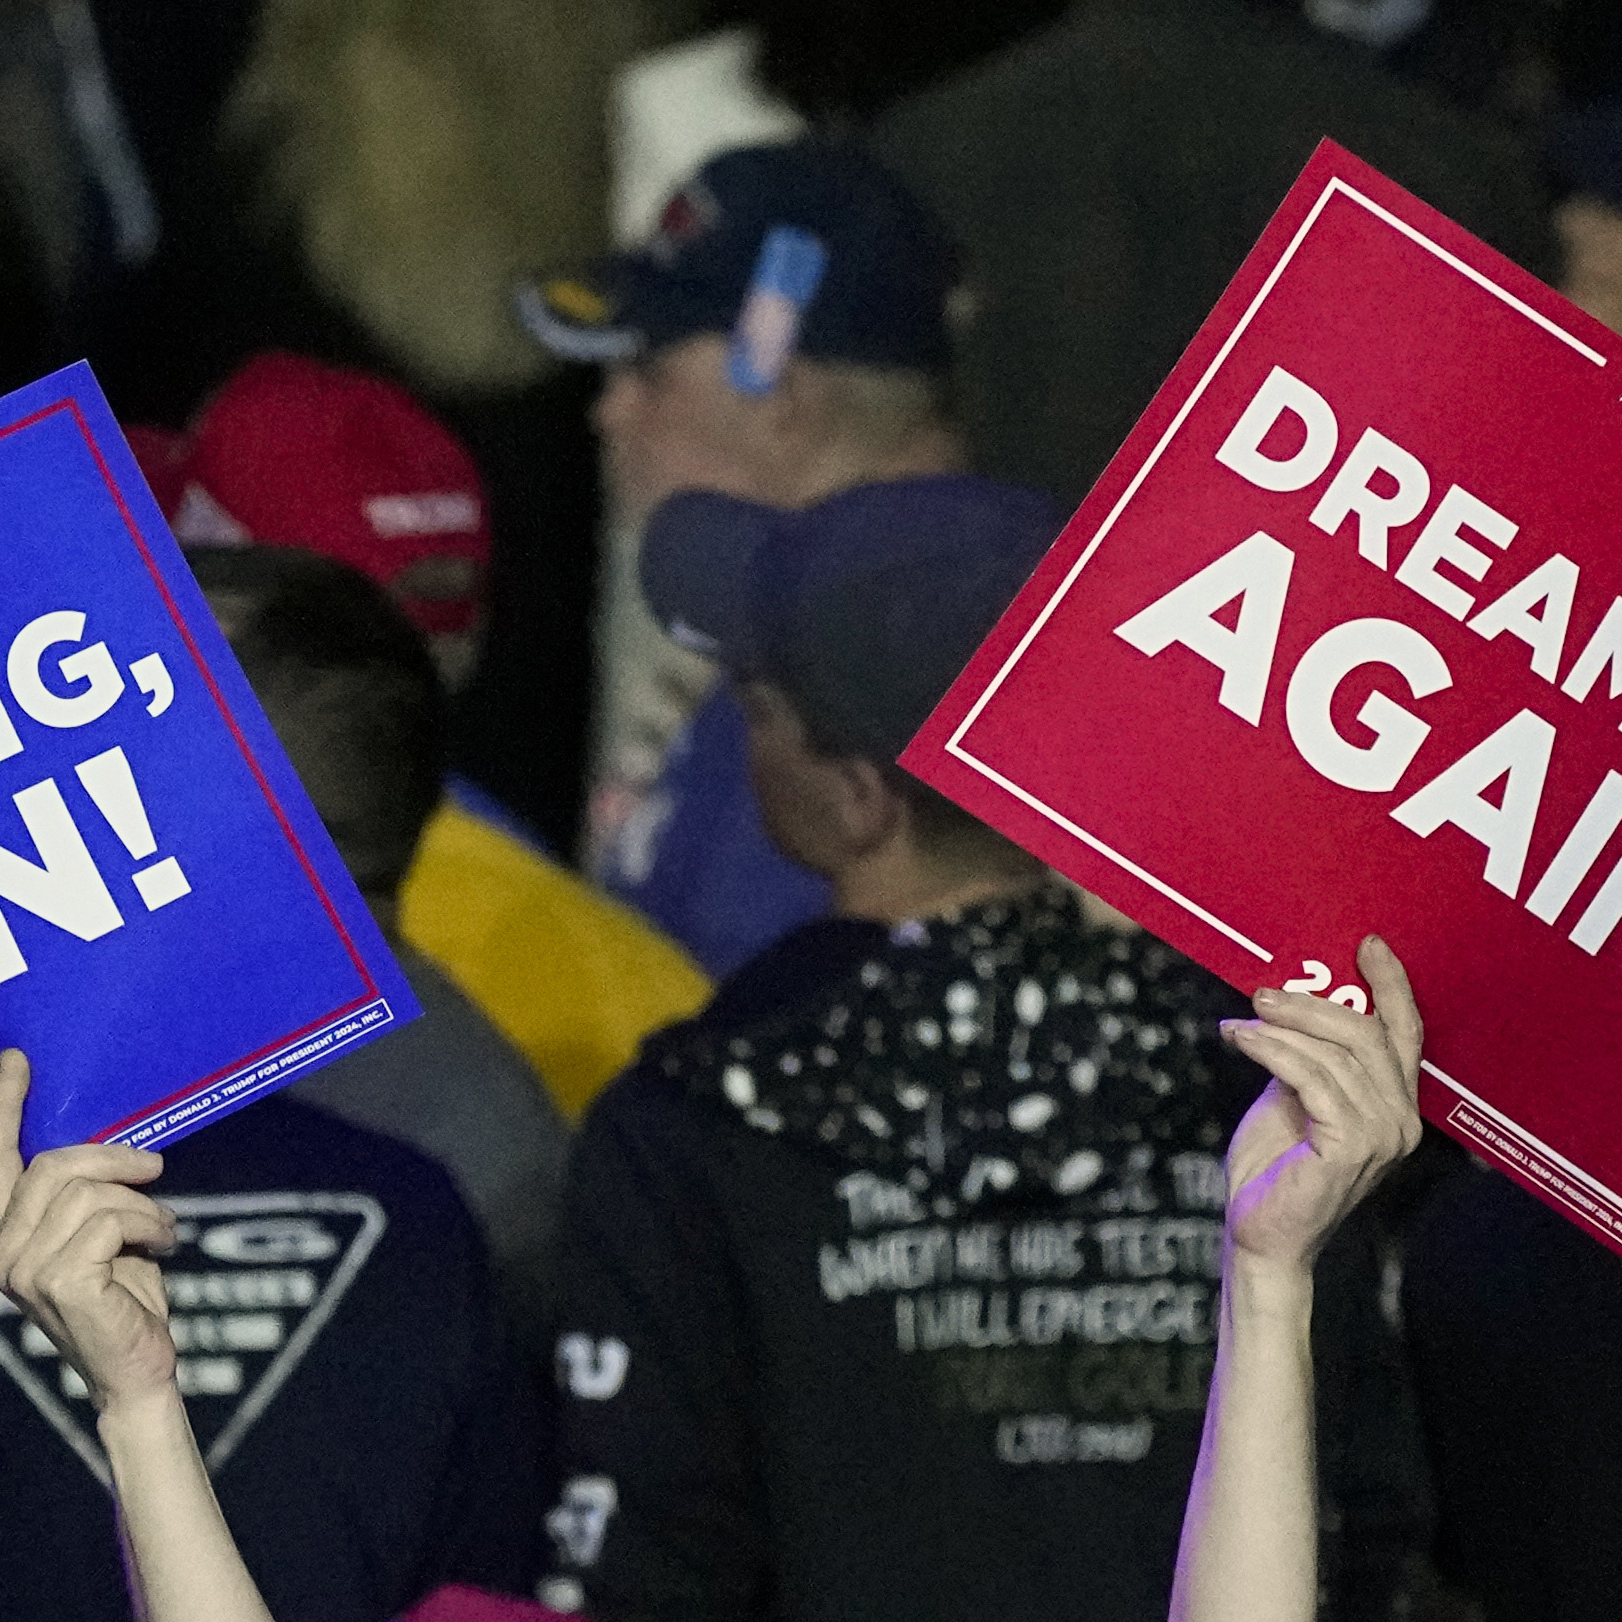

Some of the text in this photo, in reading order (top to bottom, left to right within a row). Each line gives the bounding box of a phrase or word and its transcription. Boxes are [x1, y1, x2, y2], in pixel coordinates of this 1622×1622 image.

[1282, 959, 1368, 1016] 20
[131, 1127, 153, 1143] FOR
[153, 1118, 167, 1132] BY
[168, 1097, 211, 1124] DONALD
[221, 1073, 257, 1097] TRUMP
[258, 1062, 279, 1079] FOR
[279, 1033, 334, 1067] PRESIDENT
[333, 1021, 363, 1040] 2024,
[361, 1009, 384, 1025] INC.
